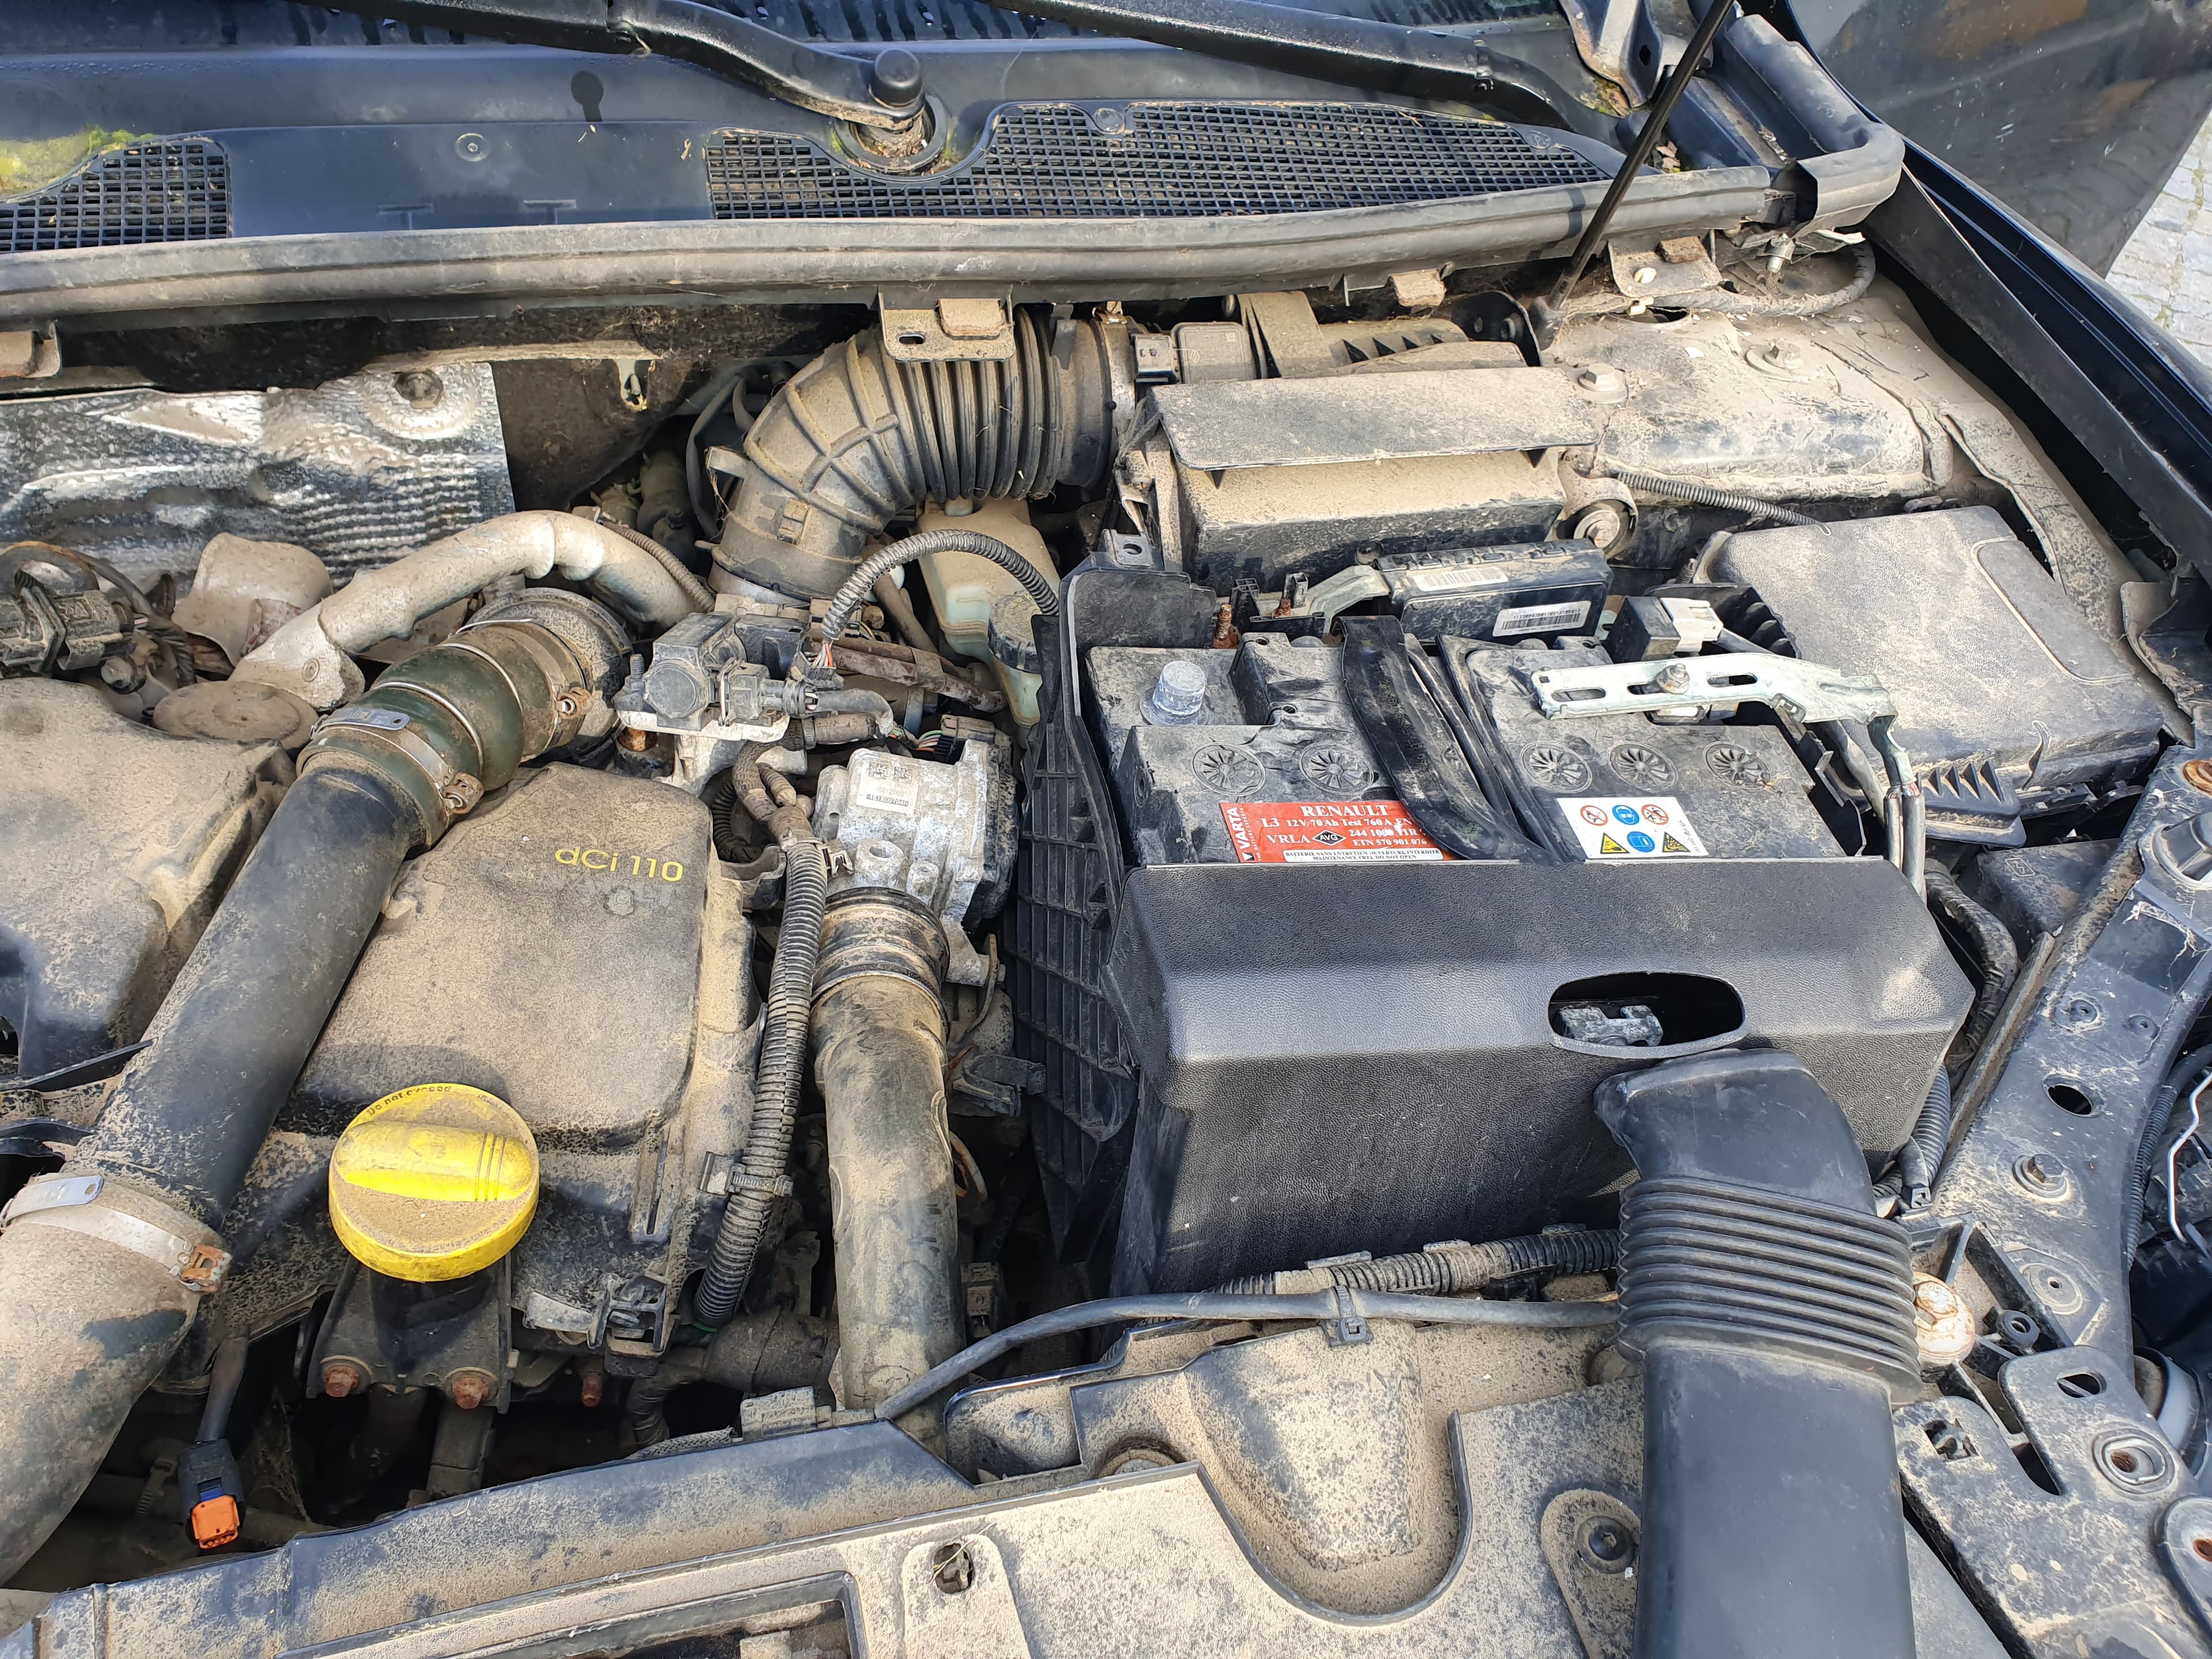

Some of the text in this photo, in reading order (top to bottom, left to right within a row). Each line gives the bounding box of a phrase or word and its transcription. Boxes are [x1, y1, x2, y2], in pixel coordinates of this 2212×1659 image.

[1300, 805, 1389, 817] RENAULT
[1226, 806, 1251, 850] VARTA
[1260, 817, 1280, 828] L3
[1286, 819, 1306, 828] 12V
[1310, 819, 1323, 827] 70
[1324, 819, 1339, 827] Ah
[1340, 818, 1362, 826] Test
[1363, 818, 1383, 826] 760
[1384, 818, 1393, 826] A
[1348, 829, 1367, 837] 244
[1266, 834, 1312, 844] VRLA
[554, 846, 684, 882] dCi 110
